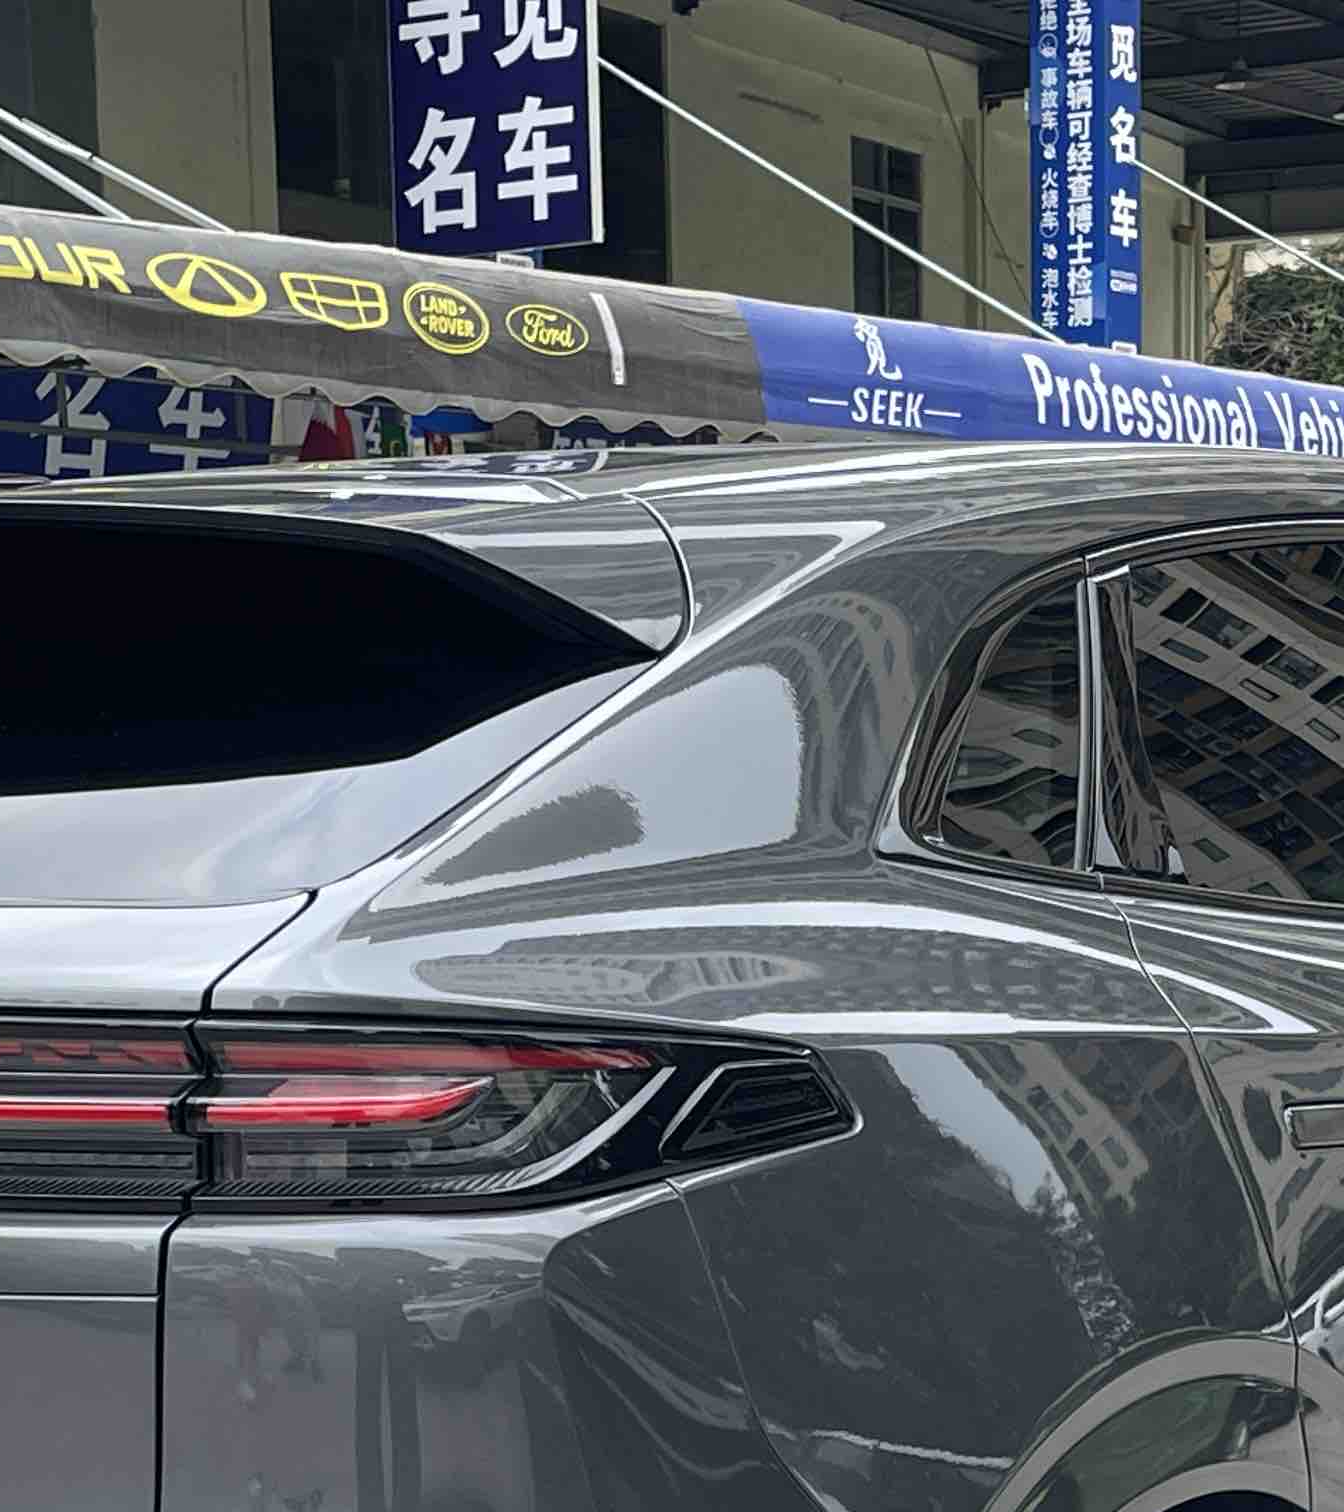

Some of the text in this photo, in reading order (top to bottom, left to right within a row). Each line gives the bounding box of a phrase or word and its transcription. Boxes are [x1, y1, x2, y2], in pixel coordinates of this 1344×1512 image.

[1040, 67, 1058, 131] 事故车
[404, 95, 578, 235] 名车
[1109, 23, 1139, 248] 觅名车
[1041, 167, 1059, 231] 火烧车
[419, 294, 459, 316] LAND
[428, 315, 475, 338] ROVER
[522, 309, 576, 349] Ford
[1041, 268, 1059, 330] 泡水车
[851, 386, 925, 429] SEEK
[1022, 352, 1259, 448] Professional
